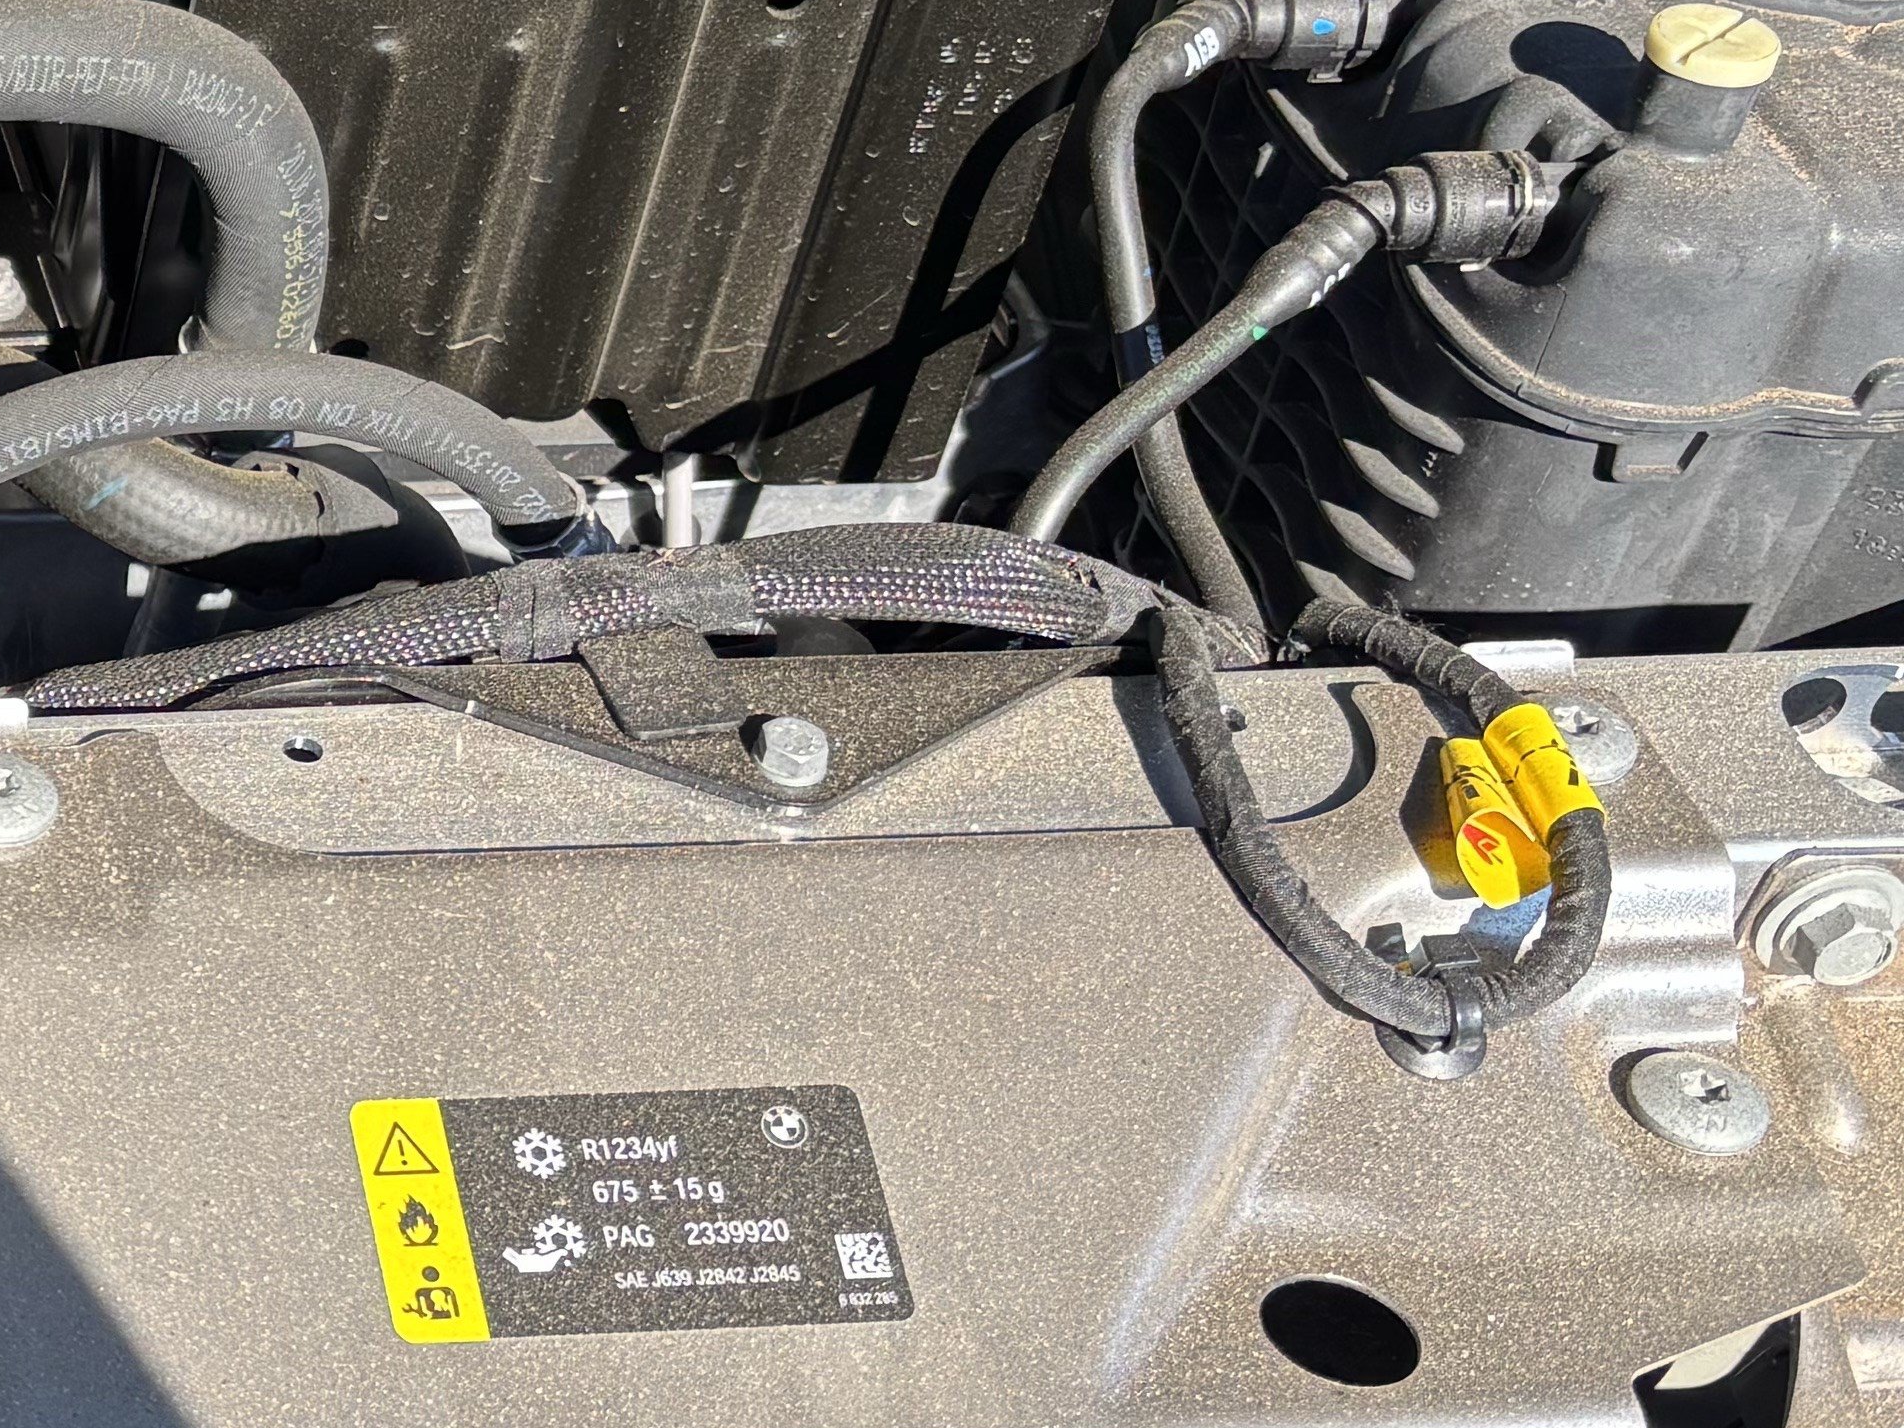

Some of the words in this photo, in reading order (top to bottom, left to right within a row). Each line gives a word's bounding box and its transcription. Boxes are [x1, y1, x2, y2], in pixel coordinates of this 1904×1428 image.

[581, 1138, 678, 1162] R1234yf
[592, 1180, 638, 1204] 675
[650, 1182, 666, 1200] ±
[672, 1178, 704, 1201] 15
[708, 1182, 724, 1204] g
[603, 1224, 655, 1248] PAG
[684, 1219, 790, 1246] 2339920
[615, 1272, 648, 1290] SAE
[652, 1270, 692, 1289] J639
[696, 1268, 748, 1288] J2842
[750, 1266, 801, 1285] J2845
